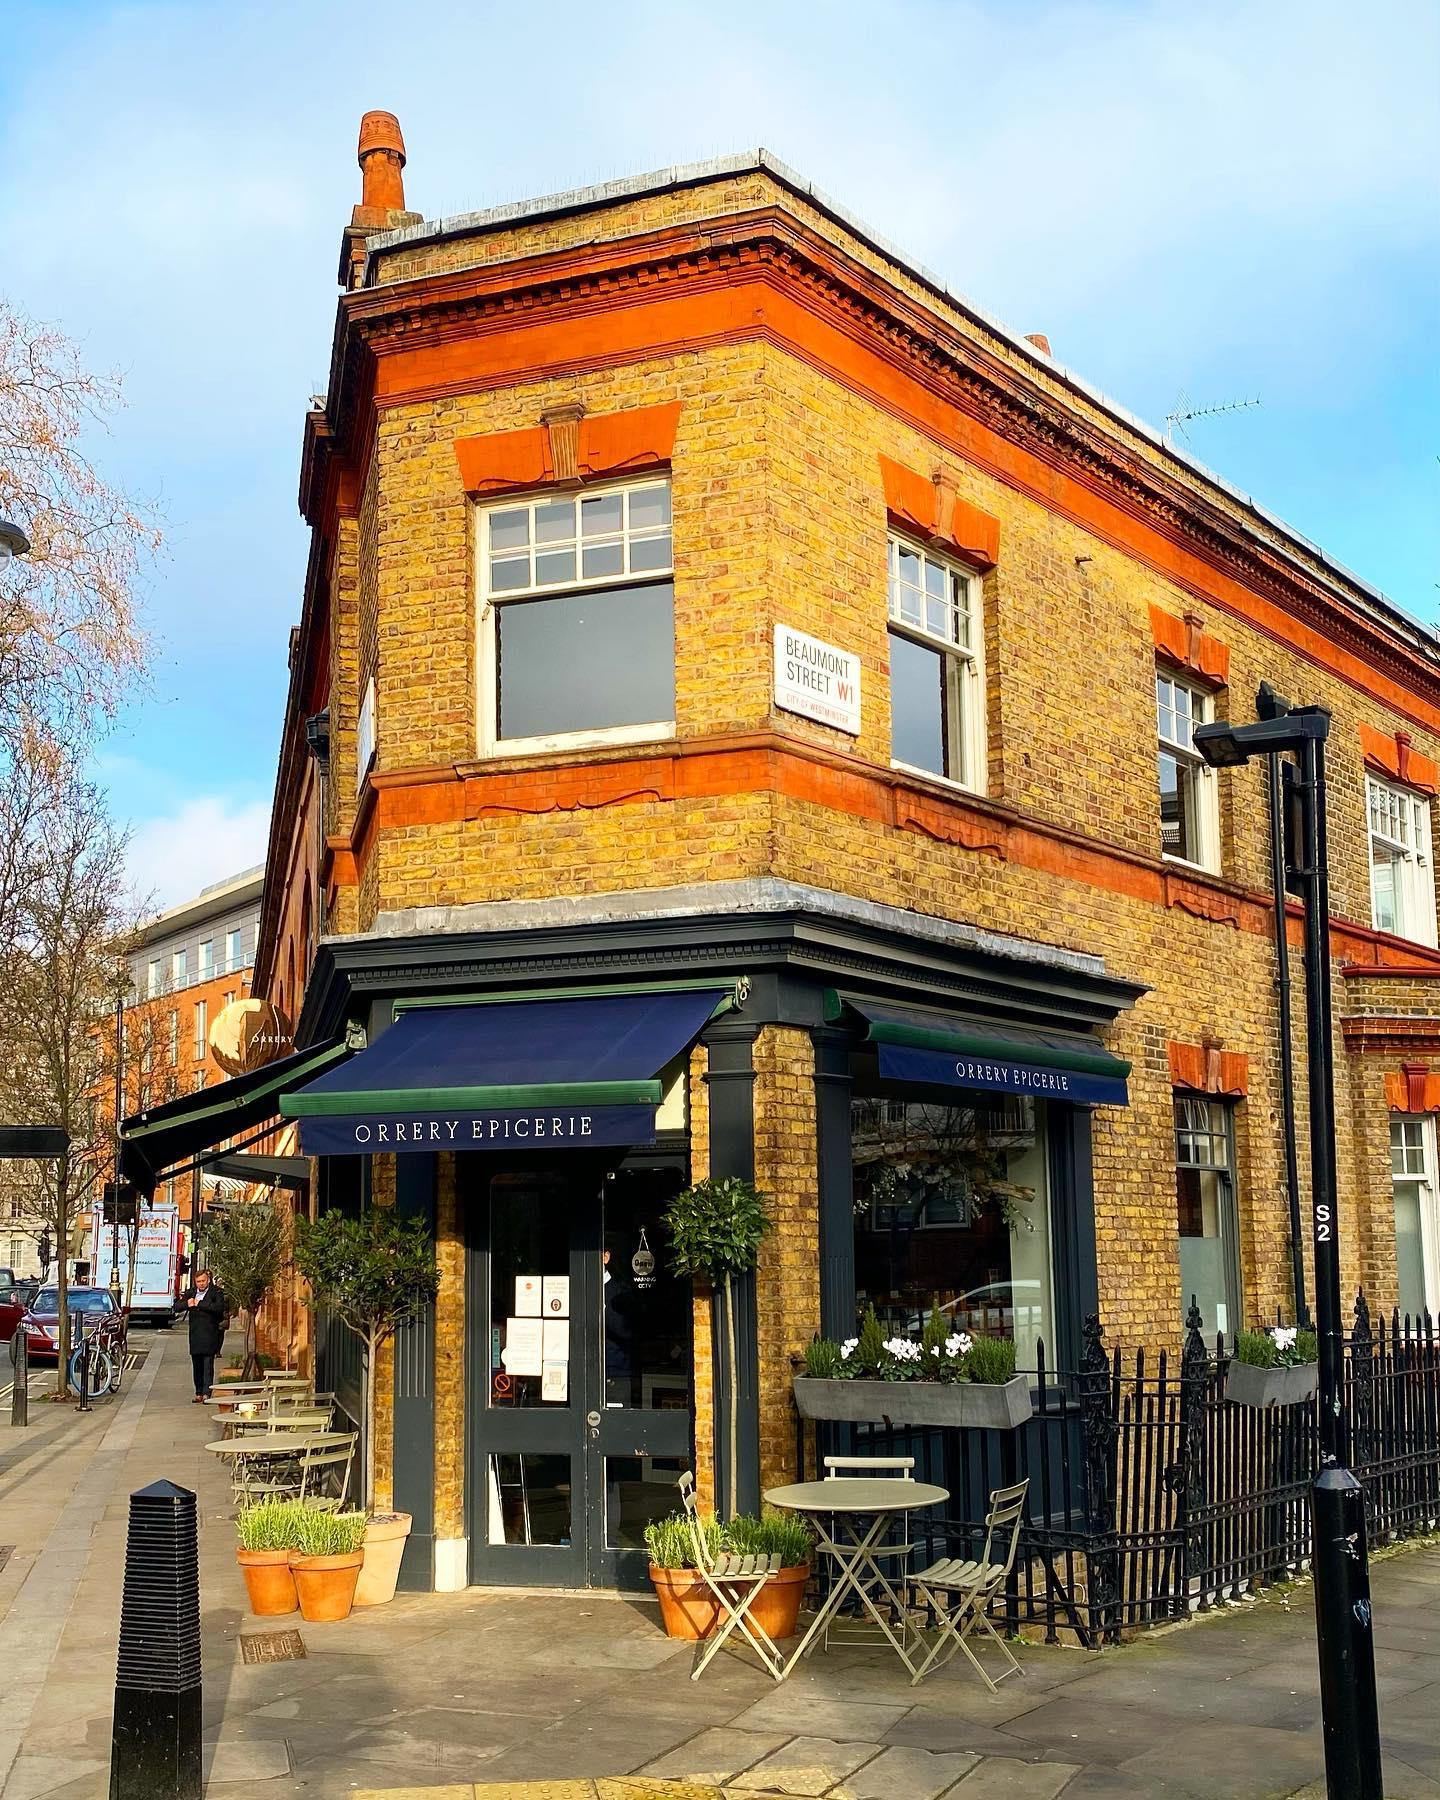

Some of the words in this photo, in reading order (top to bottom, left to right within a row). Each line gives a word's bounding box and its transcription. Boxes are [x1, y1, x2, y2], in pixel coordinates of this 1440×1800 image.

[786, 635, 850, 679] BEAUMONT
[787, 660, 831, 695] STREET
[837, 680, 854, 704] W1
[252, 1035, 293, 1043] ORRERY
[956, 1062, 1008, 1083] ORRERY
[1013, 1069, 1069, 1091] EPICERIE
[355, 1120, 459, 1143] ORRERY
[472, 1116, 592, 1140] EPICERIE
